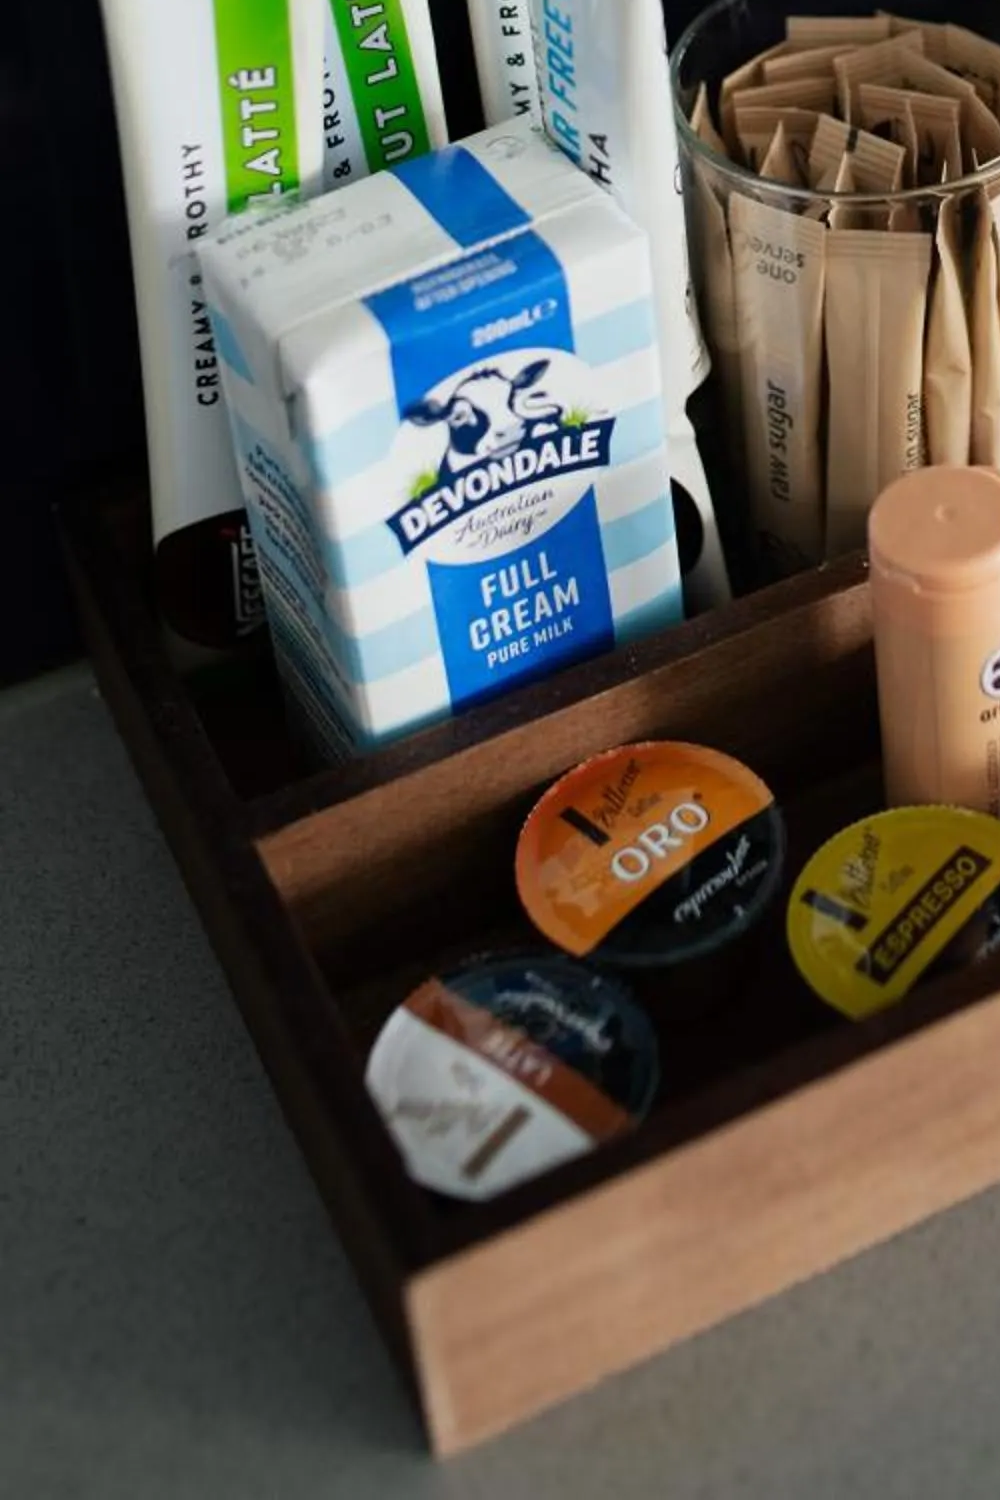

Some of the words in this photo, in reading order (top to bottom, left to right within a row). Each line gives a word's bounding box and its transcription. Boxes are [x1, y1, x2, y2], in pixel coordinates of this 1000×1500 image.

[507, 53, 526, 67] &
[228, 65, 284, 202] LATTÉ
[333, 158, 352, 179] &
[182, 143, 207, 257] ROTHY
[750, 236, 806, 268] serve
[755, 260, 797, 285] one
[765, 379, 793, 454] sugar
[400, 428, 601, 542] DEVONDALE
[768, 456, 791, 502] raw
[454, 488, 554, 542] Australian
[476, 511, 540, 548] Dairy
[480, 551, 558, 608] FULL
[469, 576, 580, 650] CREAM
[487, 637, 530, 669] PURE
[534, 615, 574, 653] MILK
[610, 802, 710, 882] ORO
[873, 855, 978, 971] ESPRESSO
